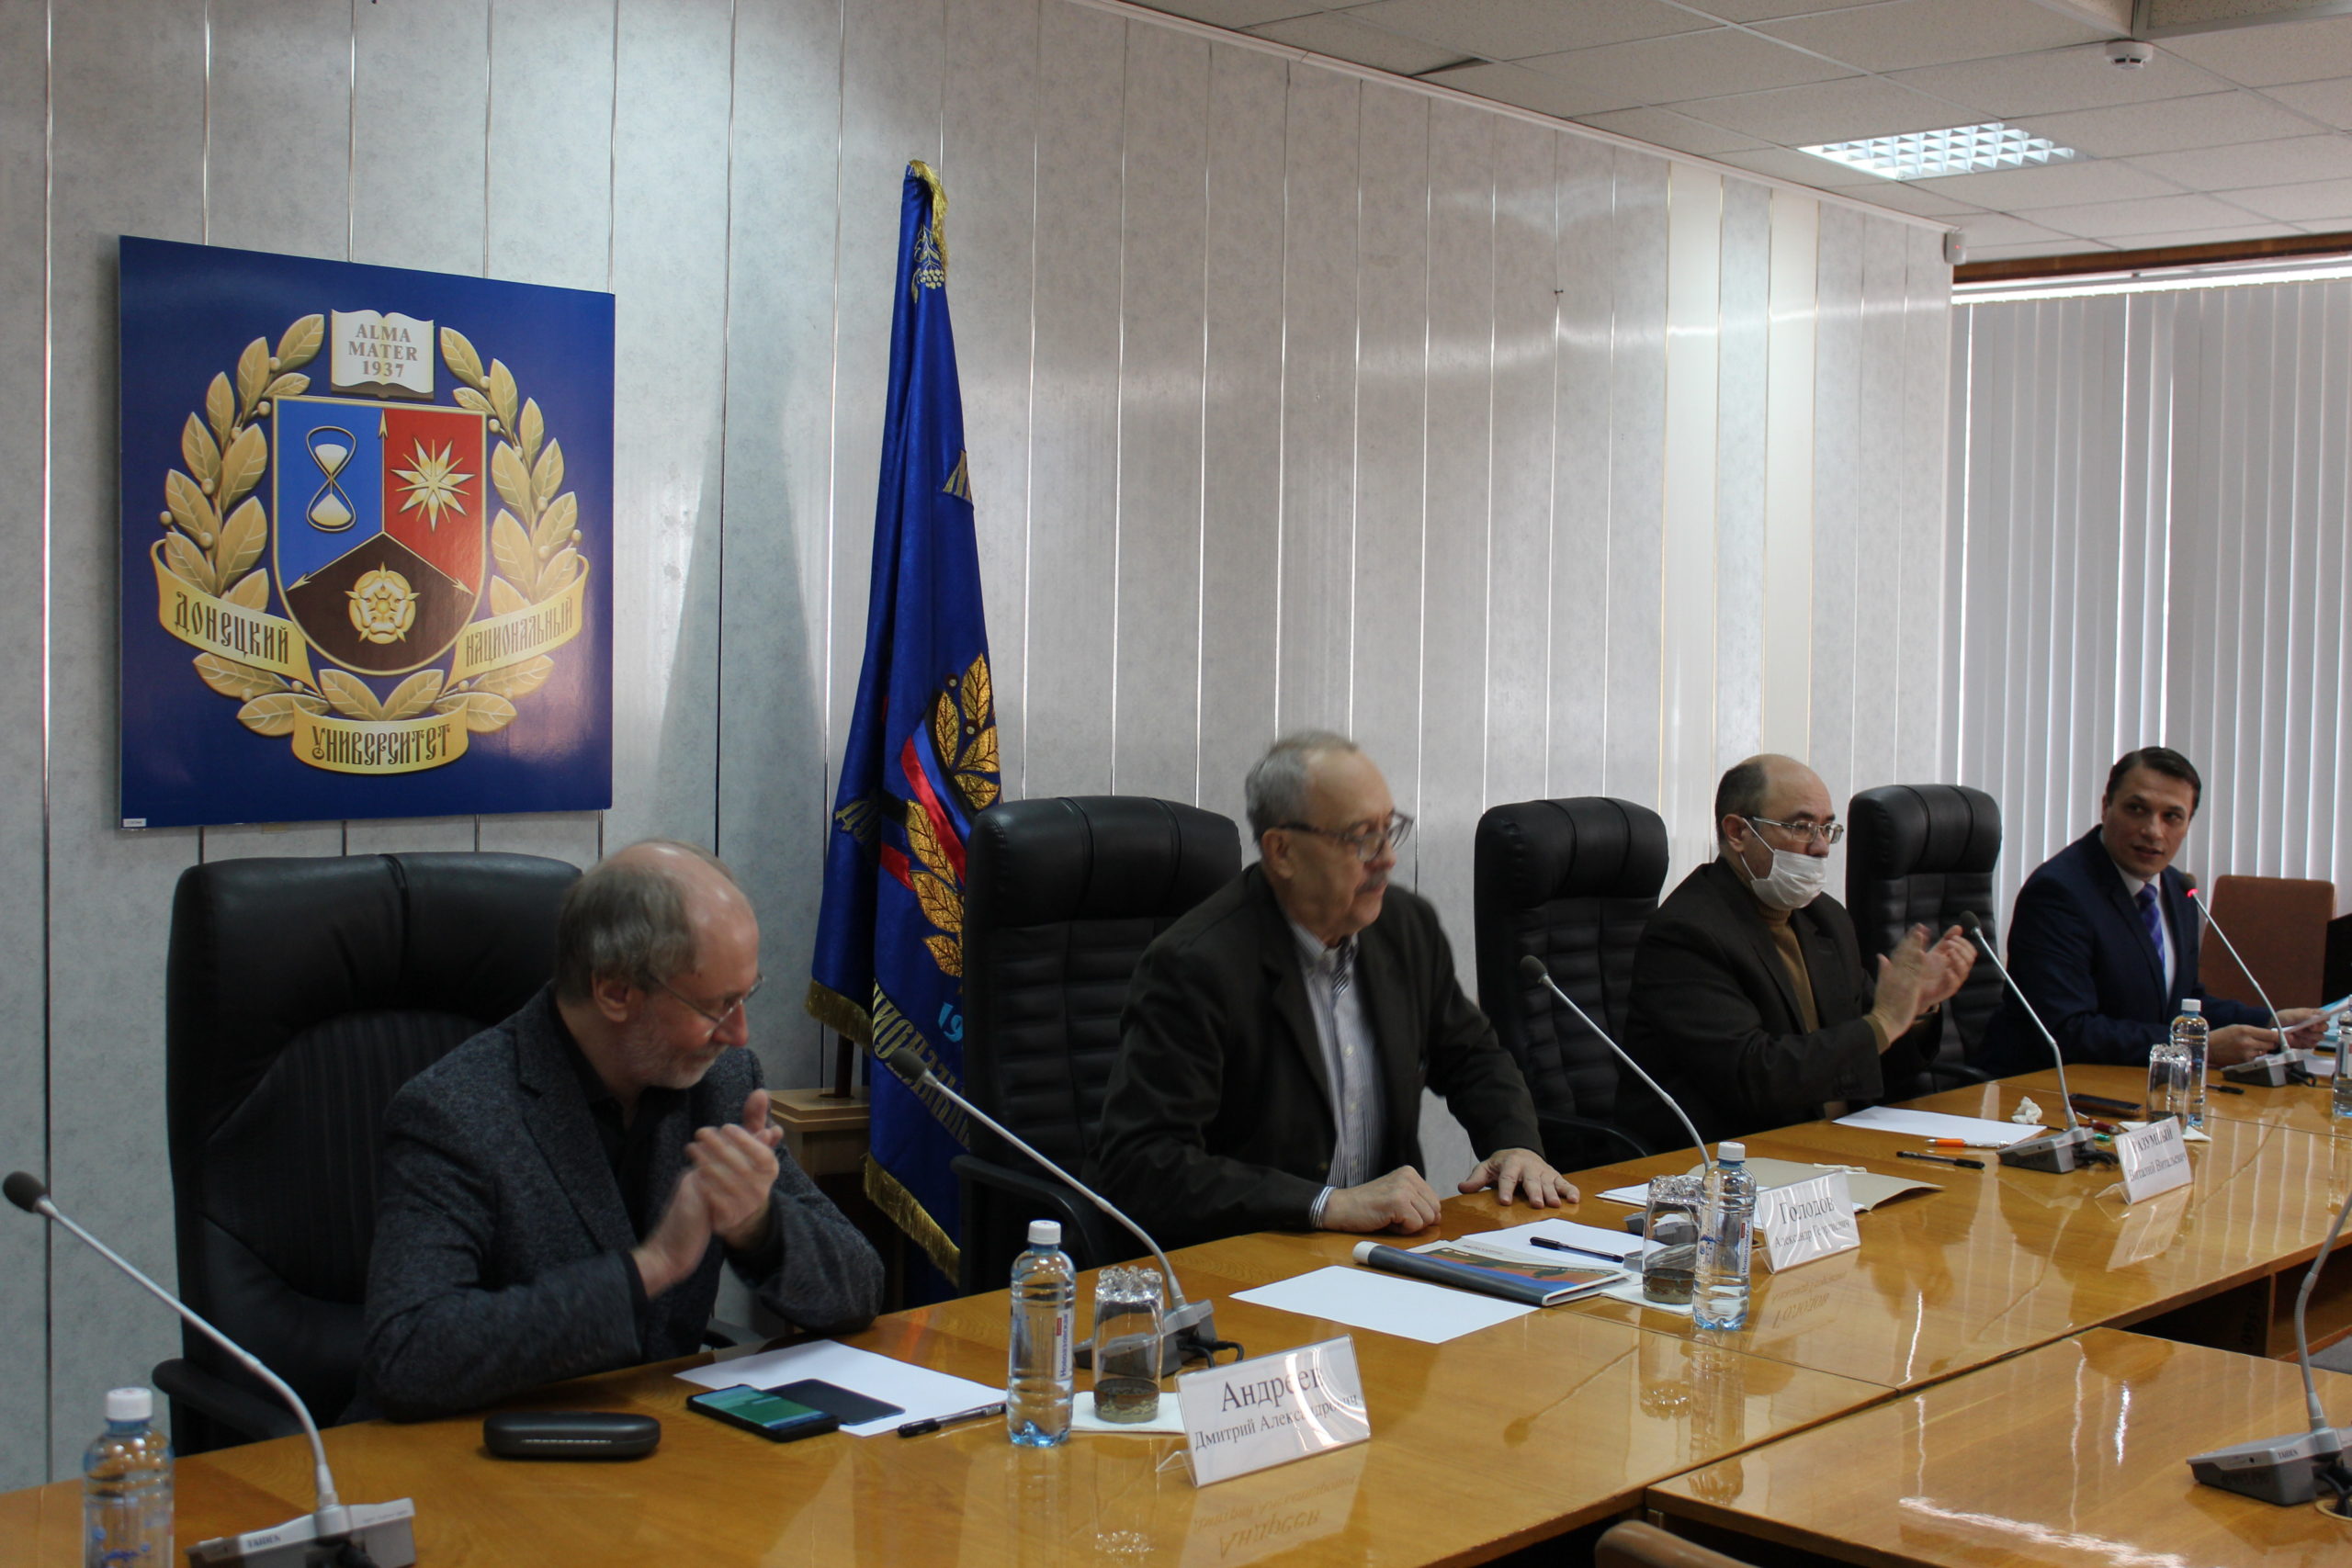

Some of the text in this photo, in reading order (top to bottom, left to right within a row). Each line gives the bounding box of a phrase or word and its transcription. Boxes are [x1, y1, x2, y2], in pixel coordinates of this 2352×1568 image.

[355, 323, 412, 343] ALMA
[347, 341, 418, 361] MATER
[362, 360, 404, 378] 1937
[175, 591, 288, 664] ДОНЕЦКИЙ
[311, 723, 450, 765] УНИВЕРСИТЕТ
[1779, 1197, 1835, 1224] Голодов
[1194, 1418, 1256, 1451] Дмитрий
